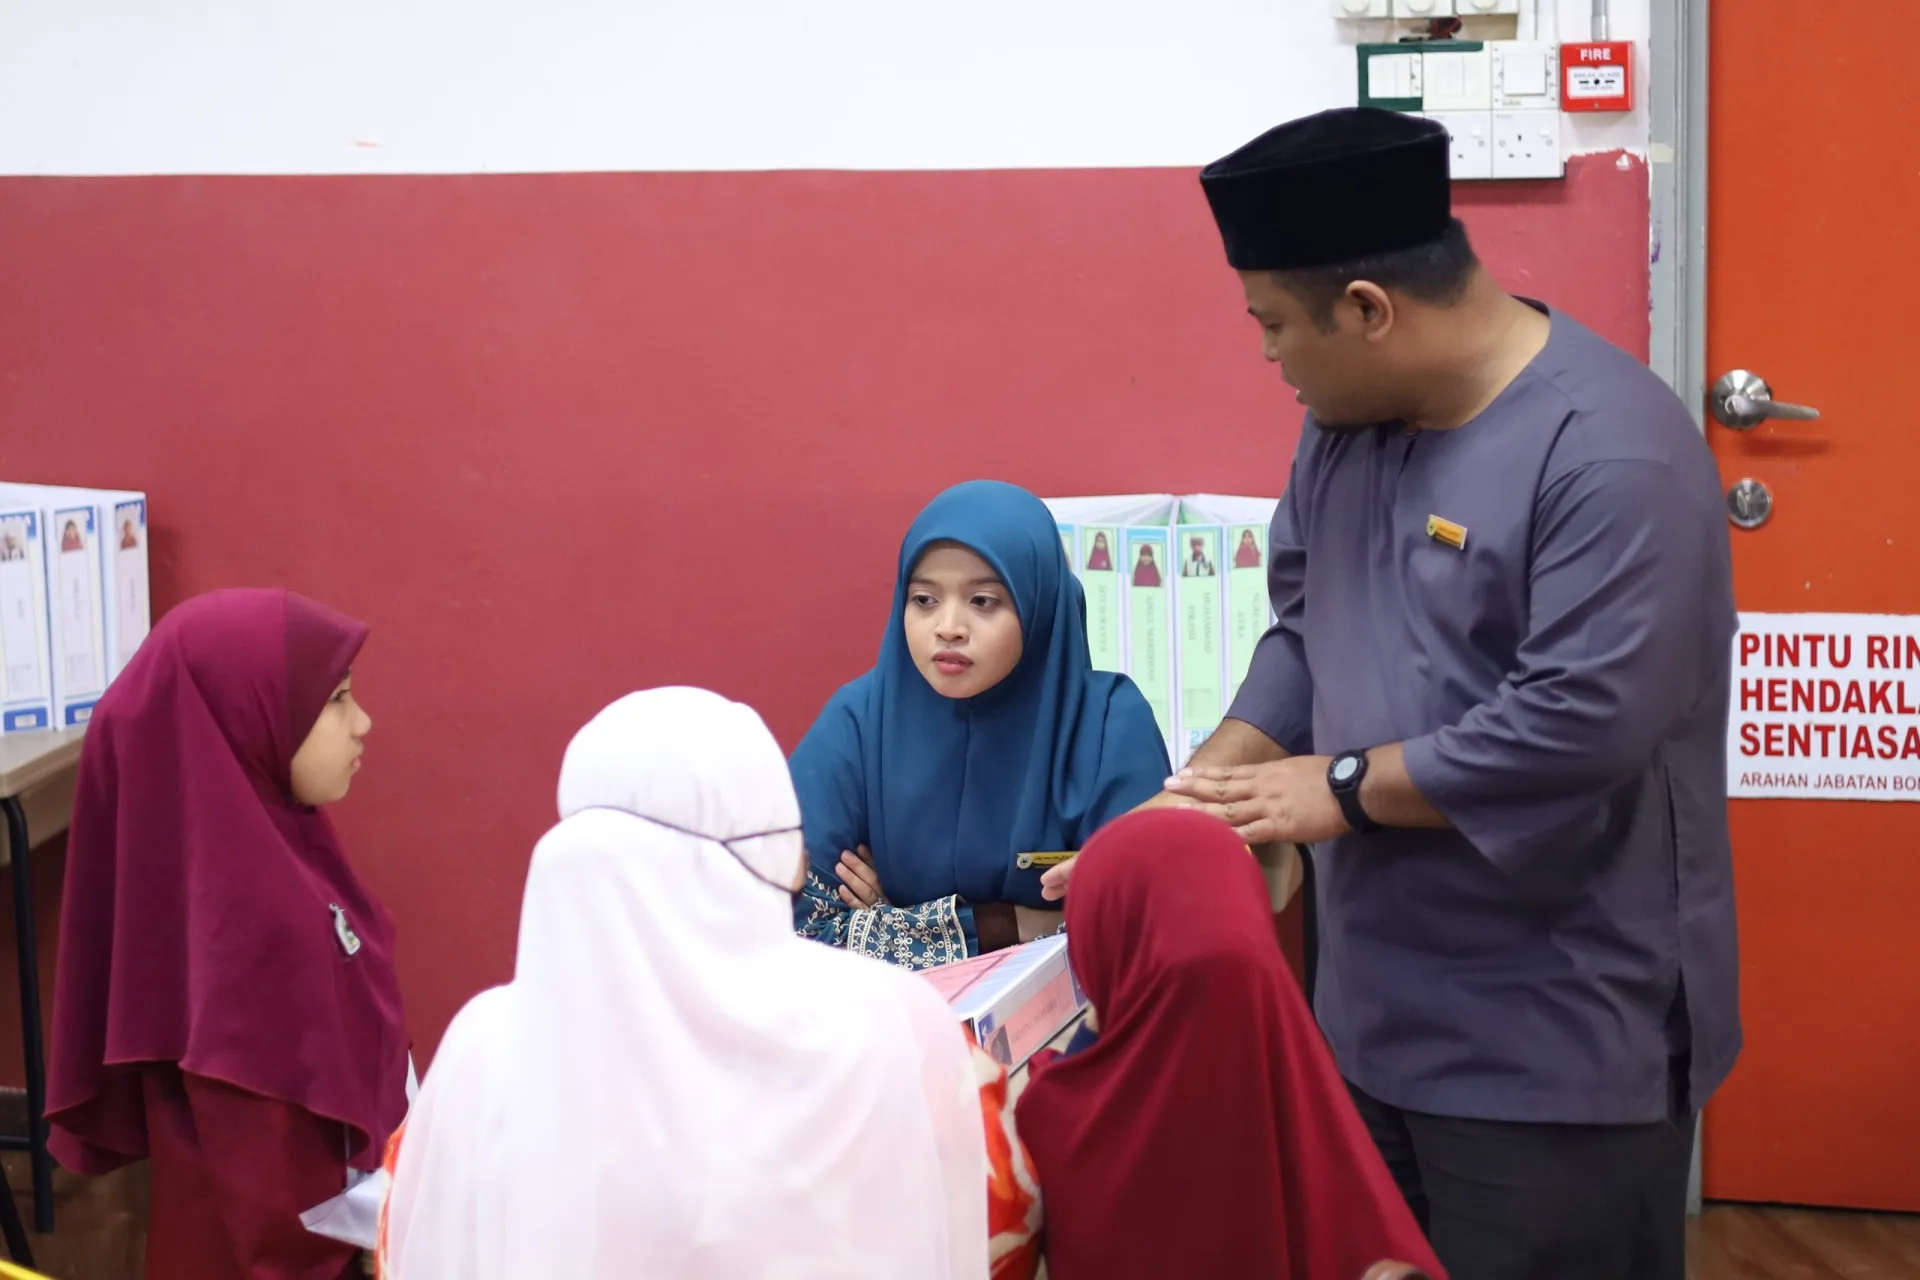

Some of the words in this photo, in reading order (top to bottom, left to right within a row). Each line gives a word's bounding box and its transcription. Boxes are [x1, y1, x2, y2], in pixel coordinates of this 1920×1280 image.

[1580, 48, 1612, 61] FIRE
[1740, 633, 1852, 669] PINTU
[1740, 678, 1920, 714] HENDAKL
[1740, 722, 1920, 760] SENTIASA
[1739, 771, 1808, 789] ARAHAN
[1814, 774, 1888, 790] JABATAN
